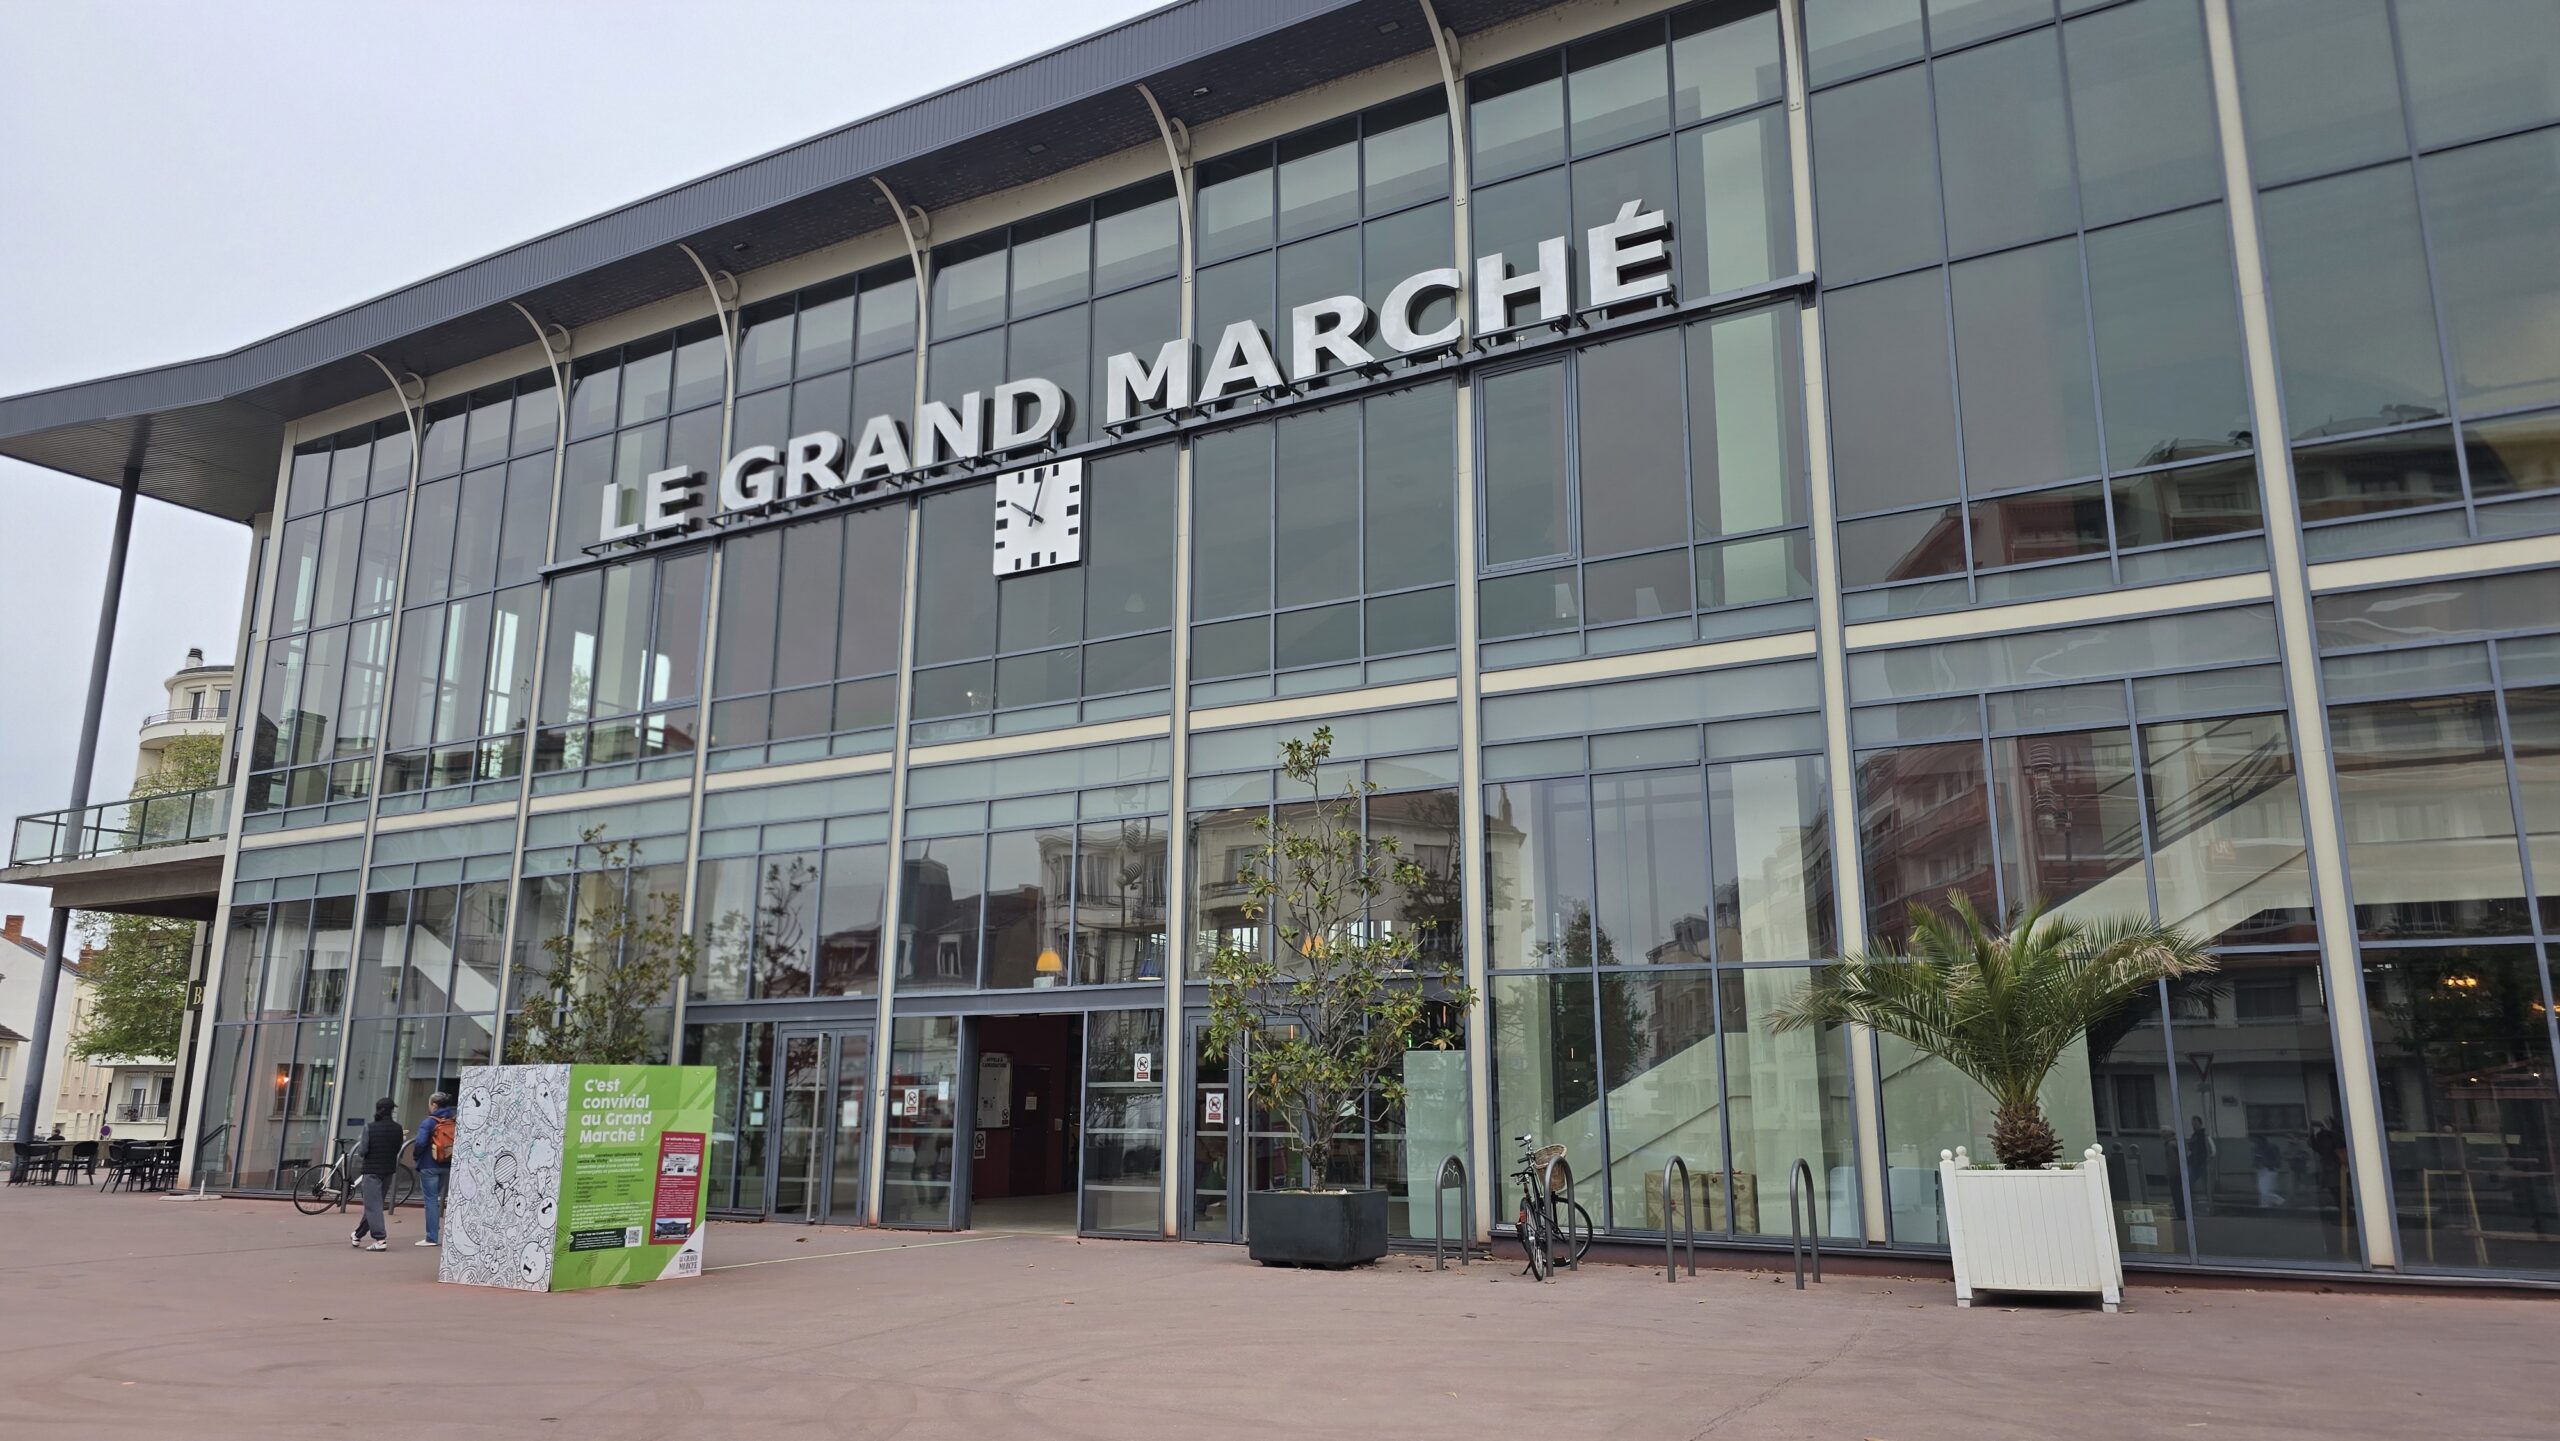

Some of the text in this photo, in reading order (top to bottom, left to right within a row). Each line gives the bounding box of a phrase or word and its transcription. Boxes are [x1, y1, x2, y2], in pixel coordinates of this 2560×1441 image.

[600, 199, 1671, 543] LE GRAND MARCHÉ
[584, 1078, 620, 1092] C'est
[582, 1094, 650, 1109] convivial
[581, 1111, 652, 1126] au Grand
[580, 1127, 645, 1143] Marché !
